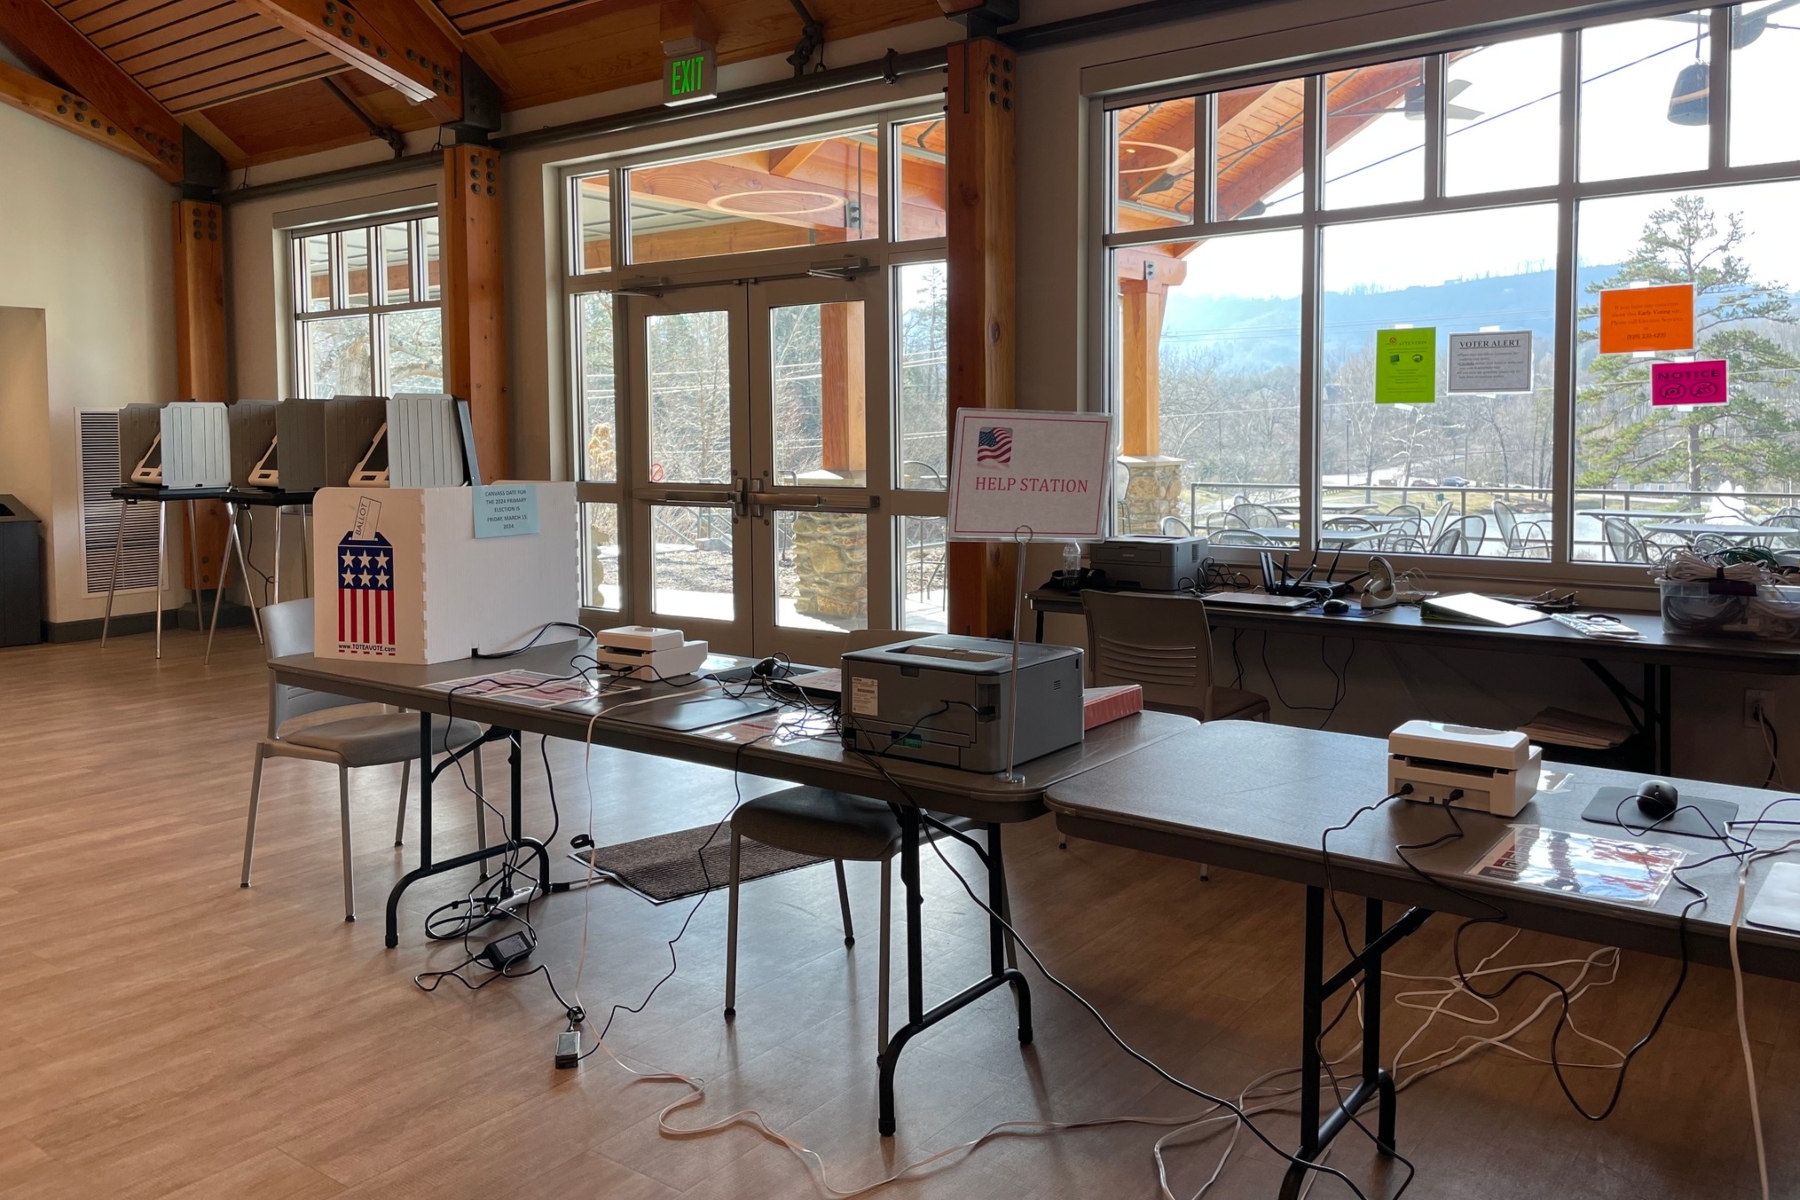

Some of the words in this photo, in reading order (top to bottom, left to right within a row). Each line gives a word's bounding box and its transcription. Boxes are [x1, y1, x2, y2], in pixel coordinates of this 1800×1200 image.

[672, 56, 704, 96] EXIT
[1658, 370, 1719, 380] NOTICE
[975, 476, 1016, 491] HELP
[1020, 478, 1089, 493] STATION
[355, 502, 368, 536] BALLOT
[338, 644, 396, 652] www.TOTEAVOTE.com
